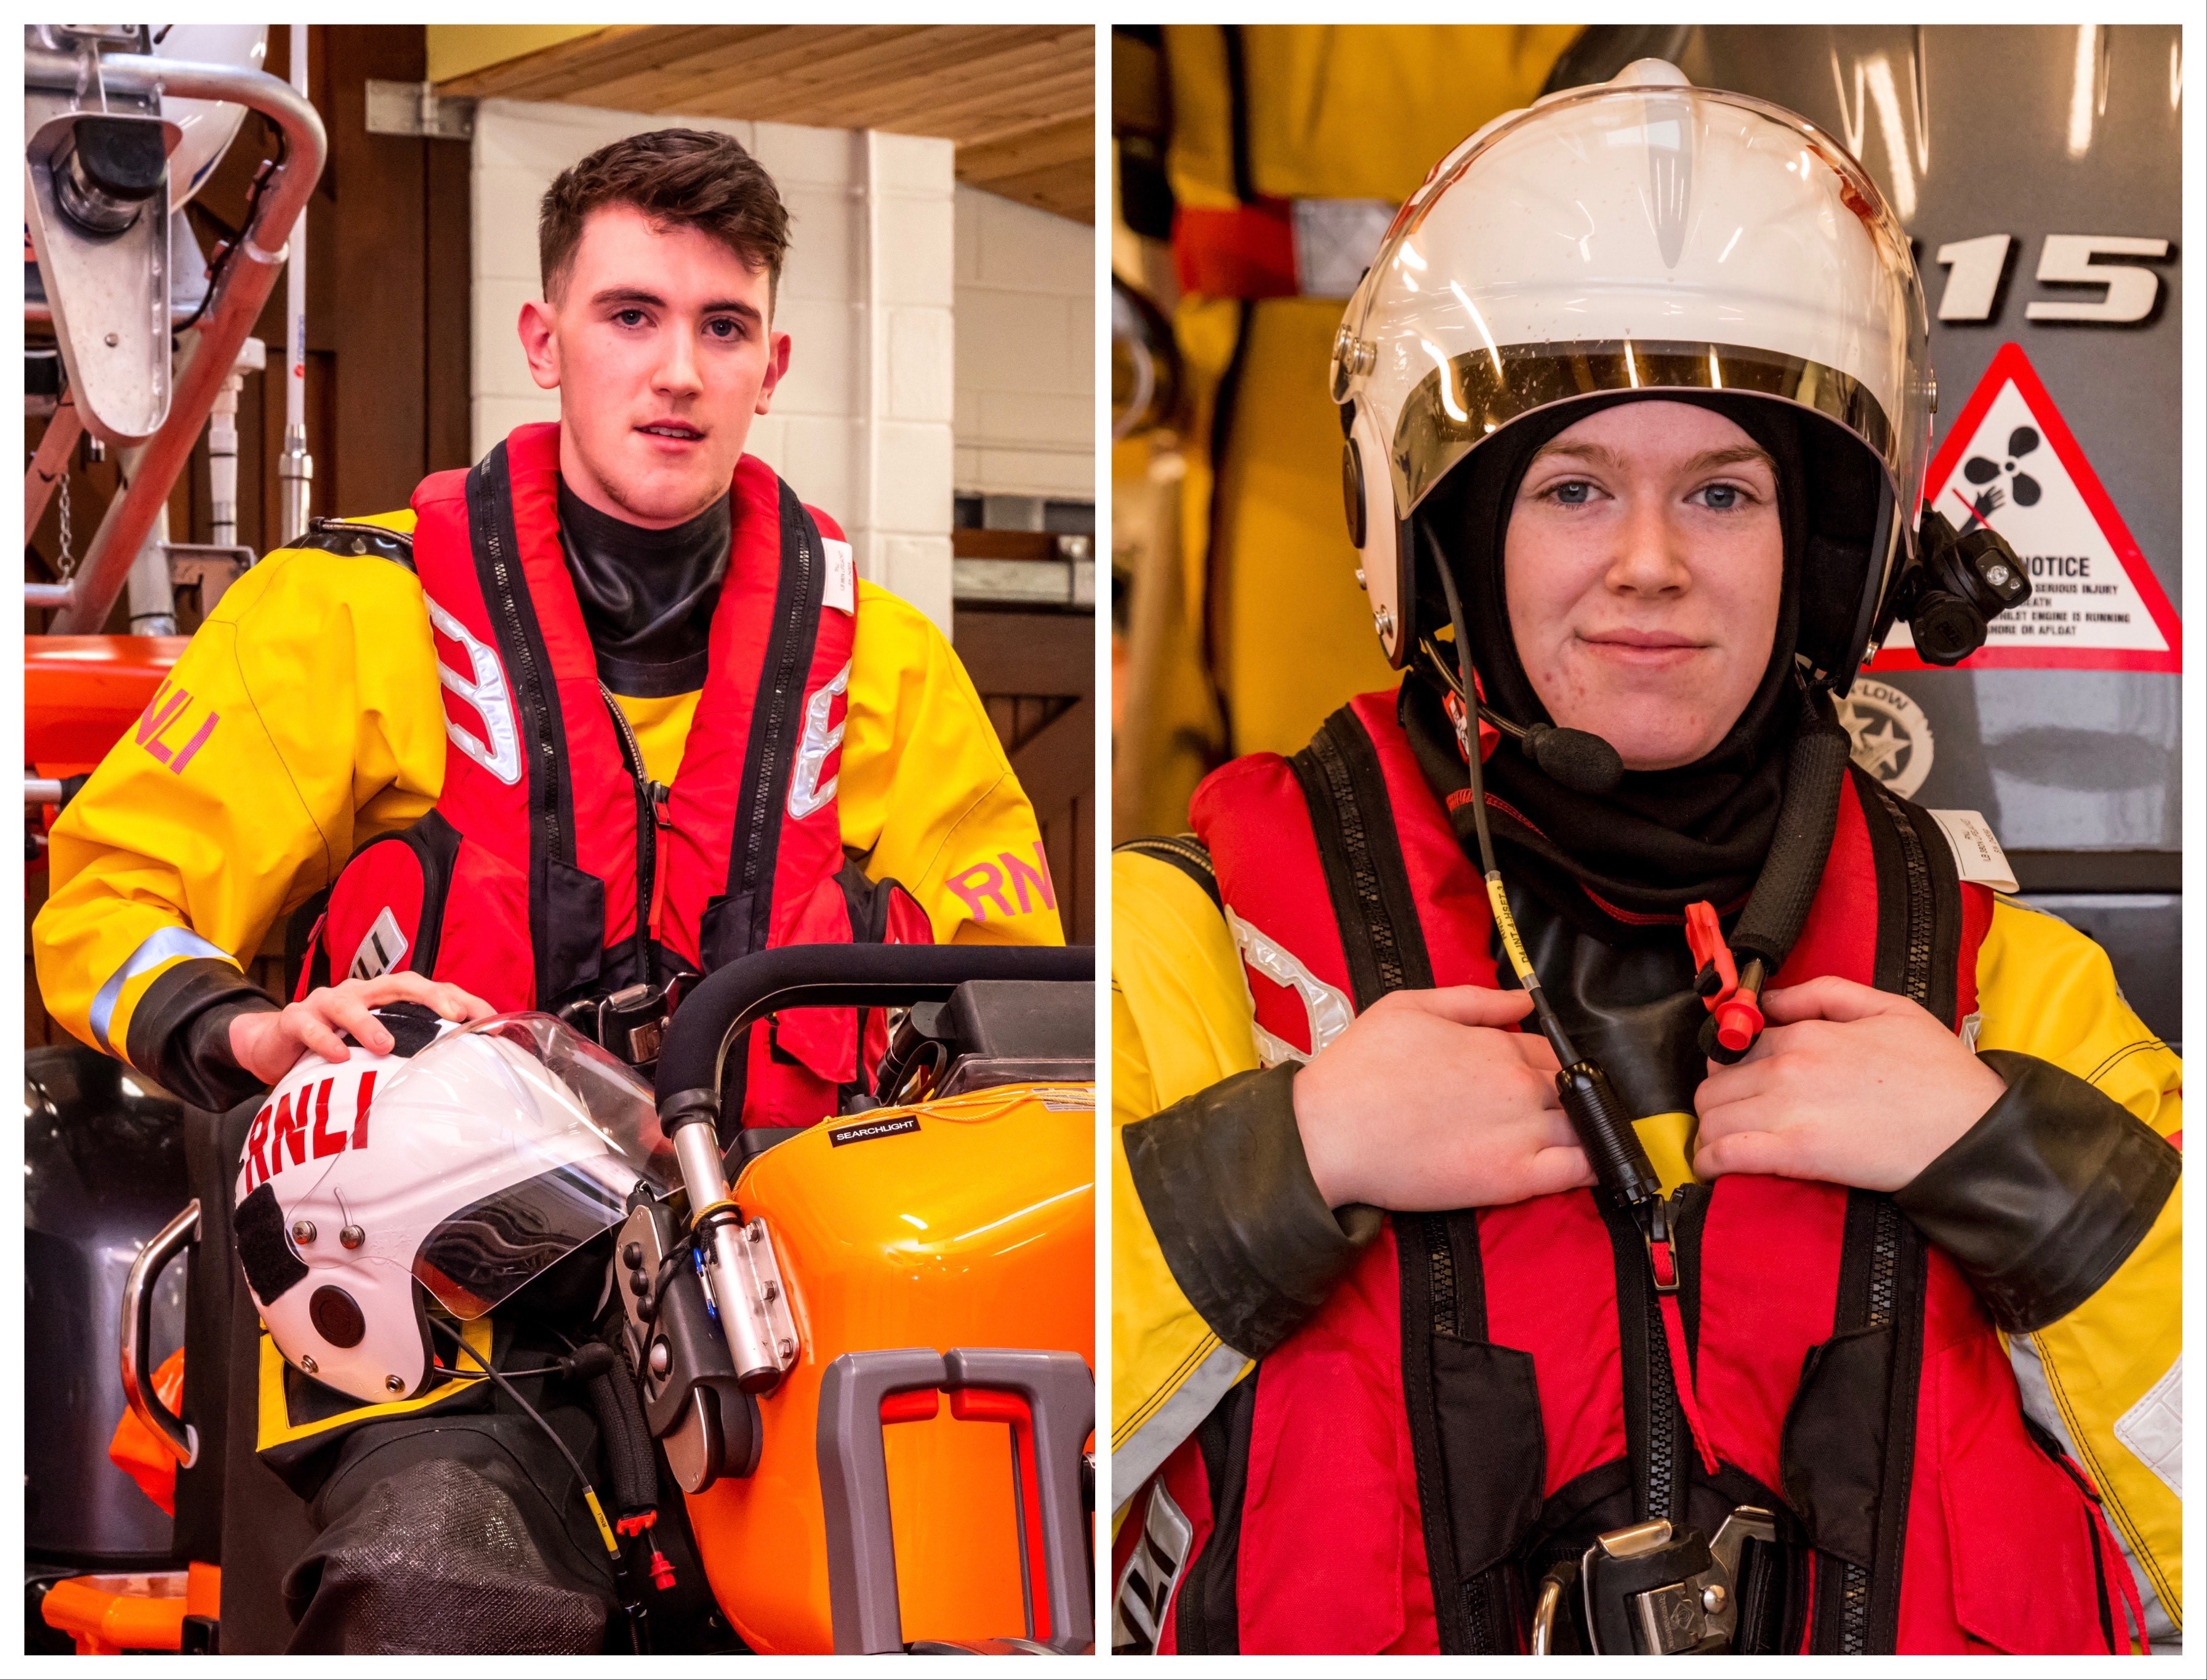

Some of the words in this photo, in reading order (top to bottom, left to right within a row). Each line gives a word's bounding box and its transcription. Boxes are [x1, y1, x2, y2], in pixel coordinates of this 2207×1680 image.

[1907, 234, 2169, 323] 15
[2035, 584, 2078, 593] SERIOUS
[2082, 584, 2118, 594] INJURY
[2032, 612, 2067, 621] ENGINE
[2073, 613, 2081, 621] IS
[2086, 613, 2130, 622] RUNNING
[2022, 625, 2033, 634] OR
[2039, 626, 2076, 635] AFLOAT
[246, 1070, 378, 1196] RNLI
[836, 1120, 914, 1141] SEARCHLIGHT
